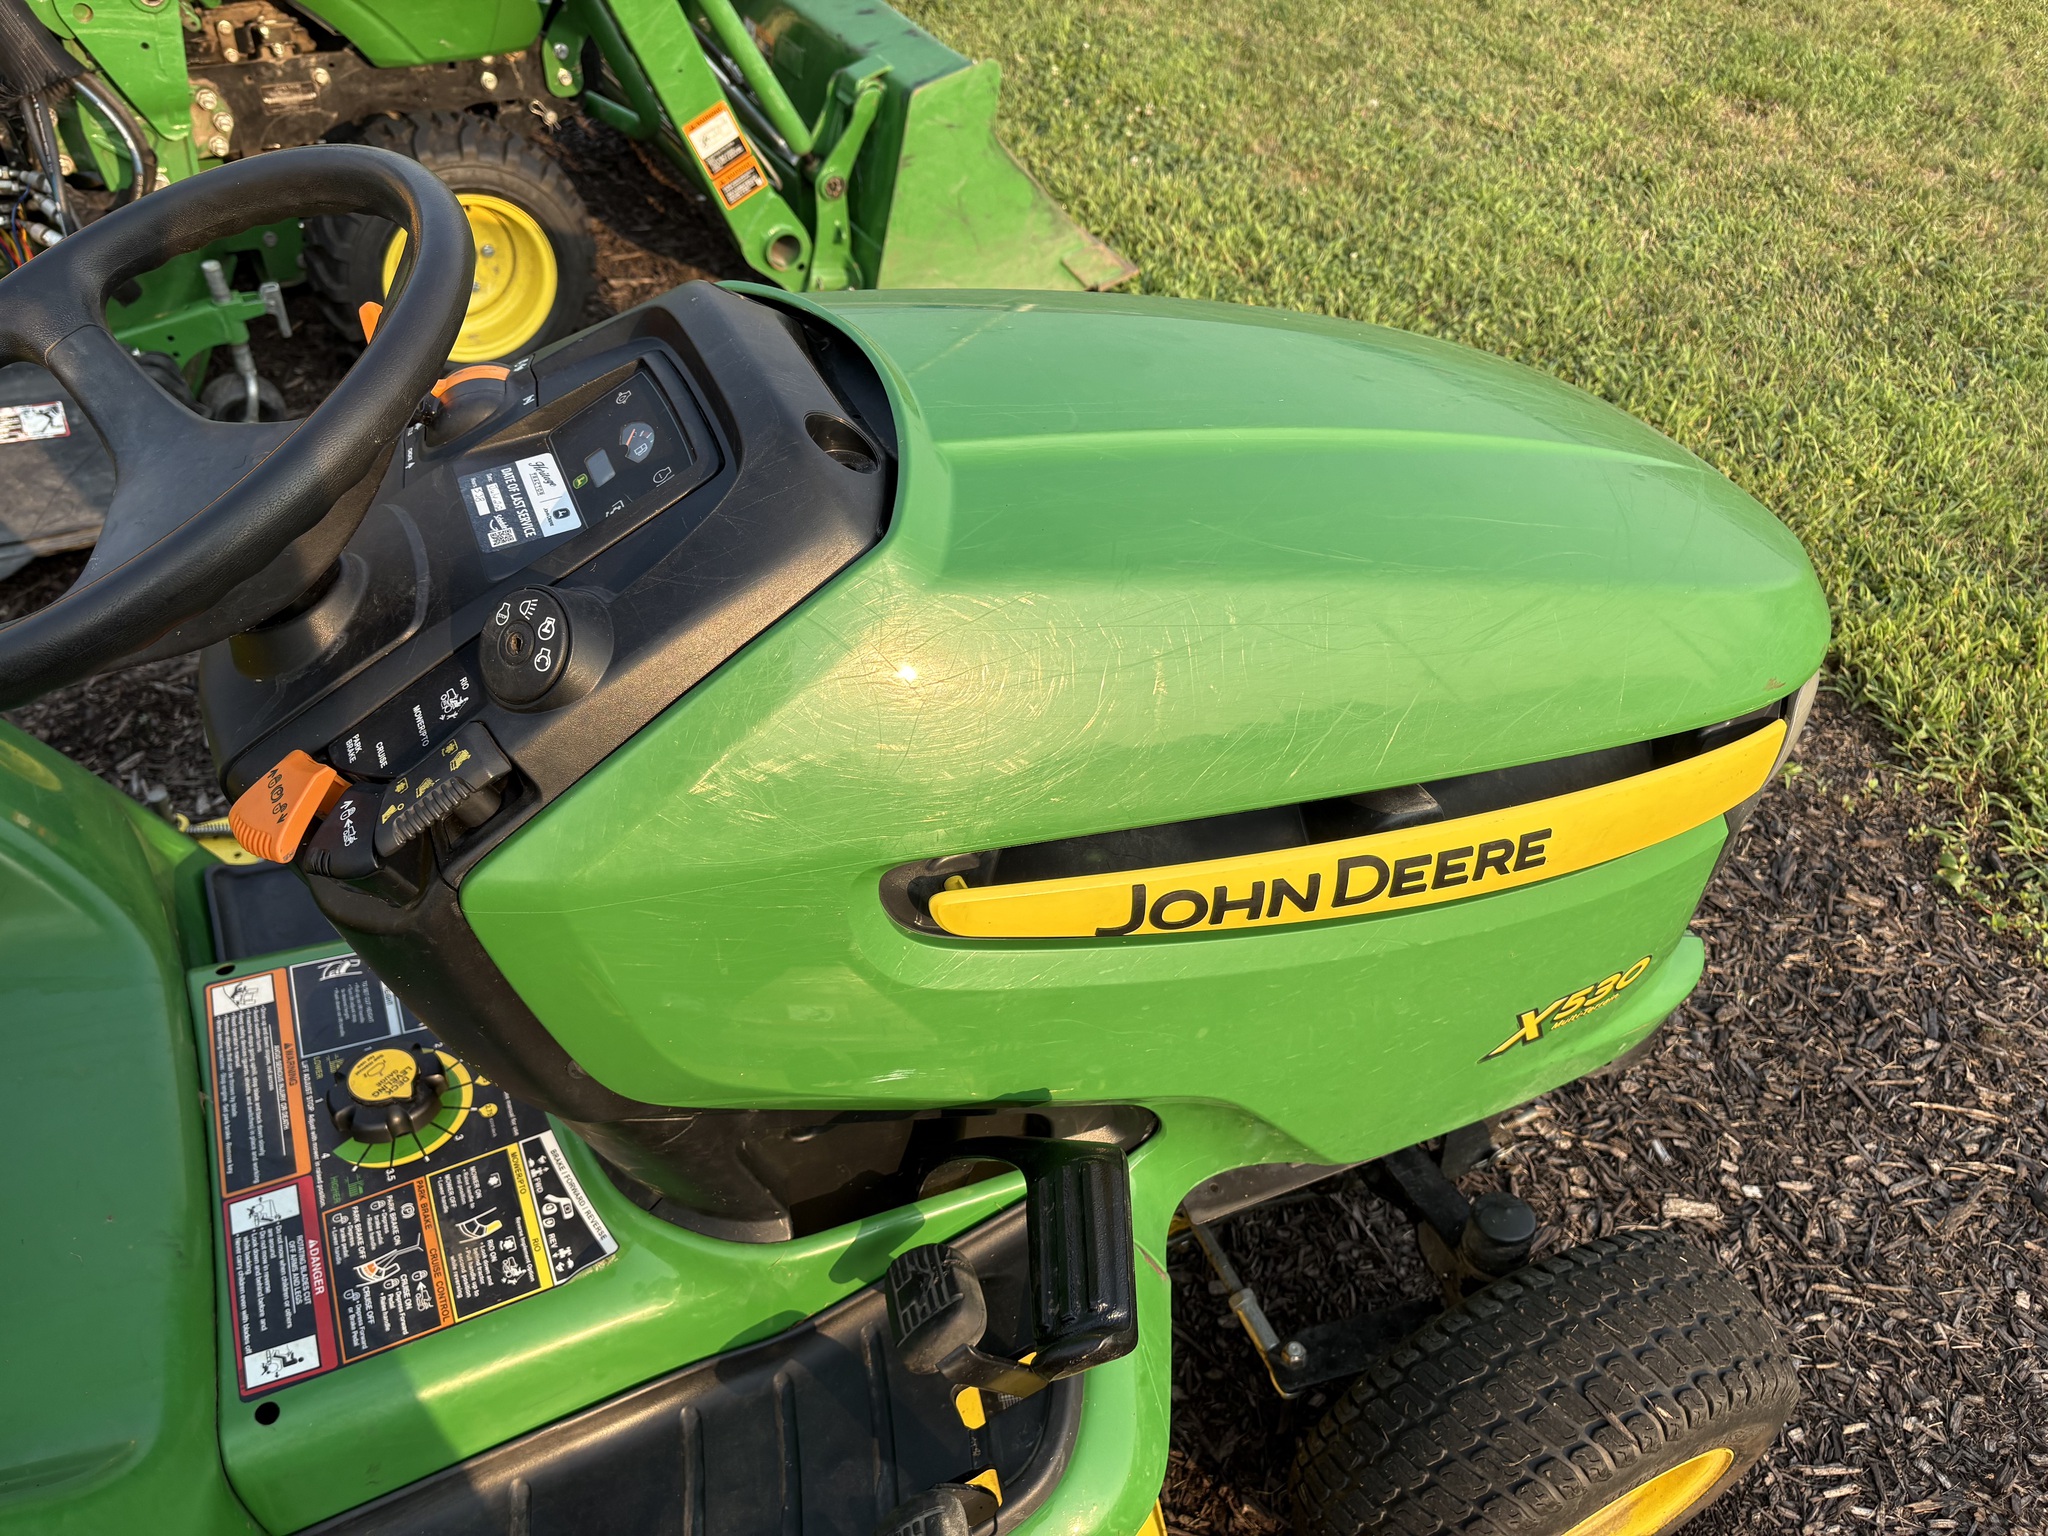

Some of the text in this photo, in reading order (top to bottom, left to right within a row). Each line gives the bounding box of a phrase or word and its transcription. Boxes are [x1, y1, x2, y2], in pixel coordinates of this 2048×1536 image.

[530, 472, 544, 495] TRACTOR
[500, 467, 536, 537] DATE OF LAST SERVICE
[460, 677, 469, 690] RIO
[352, 733, 362, 754] PARK
[413, 704, 430, 747] MOWER/PTO
[346, 739, 357, 763] BRAKE
[375, 742, 388, 768] CRUISE
[1095, 828, 1552, 937] JOHN DEERE
[1477, 954, 1652, 1064] X530
[284, 1048, 297, 1086] WARNING
[312, 1056, 323, 1079] LOWER
[371, 1065, 412, 1098] LEVELING
[384, 1075, 410, 1095] DECK
[320, 1151, 330, 1159] 4
[509, 1151, 527, 1194] MOWER/PTO
[329, 1175, 341, 1203] HIGHER
[385, 1167, 396, 1181] 3.5
[444, 1173, 457, 1209] MOWER OFF
[469, 1165, 482, 1199] MOWER ON
[533, 1176, 544, 1194] FWD
[416, 1179, 432, 1230] PARK BRAKE
[550, 1148, 607, 1242] BRAKE FORWARD REVERSE
[351, 1205, 366, 1260] PARK BRAKE OFF
[386, 1194, 401, 1246] PARK BRAKE ON
[233, 1237, 241, 1254] Never
[331, 1229, 342, 1265] Lower handle
[486, 1238, 497, 1262] RIO ON
[531, 1237, 541, 1252] RIO
[547, 1231, 558, 1250] REV
[234, 1255, 242, 1270] carry
[287, 1240, 302, 1305] OFF ARMS AND LEGS
[295, 1234, 311, 1306] ROTATING BLADES CUT
[309, 1247, 324, 1296] DANGER
[449, 1254, 463, 1299] while reversing
[456, 1252, 471, 1298] second position
[472, 1247, 485, 1285] behind tractor
[479, 1245, 494, 1286] Look down and
[236, 1270, 246, 1294] children
[249, 1232, 268, 1331] Look down and behind before and
[400, 1273, 412, 1310] CRUISE ON
[429, 1247, 450, 1322] CRUISE CONTROL
[241, 1309, 249, 1323] with
[362, 1285, 375, 1325] CRUISE OFF
[379, 1295, 390, 1332] Raise handle
[387, 1292, 395, 1309] Pedal
[394, 1289, 408, 1335] Depress Forward
[242, 1323, 251, 1344] blades
[347, 1306, 359, 1347] or Brake Pedal
[354, 1303, 367, 1349] Depress Forward
[244, 1344, 252, 1355] off
